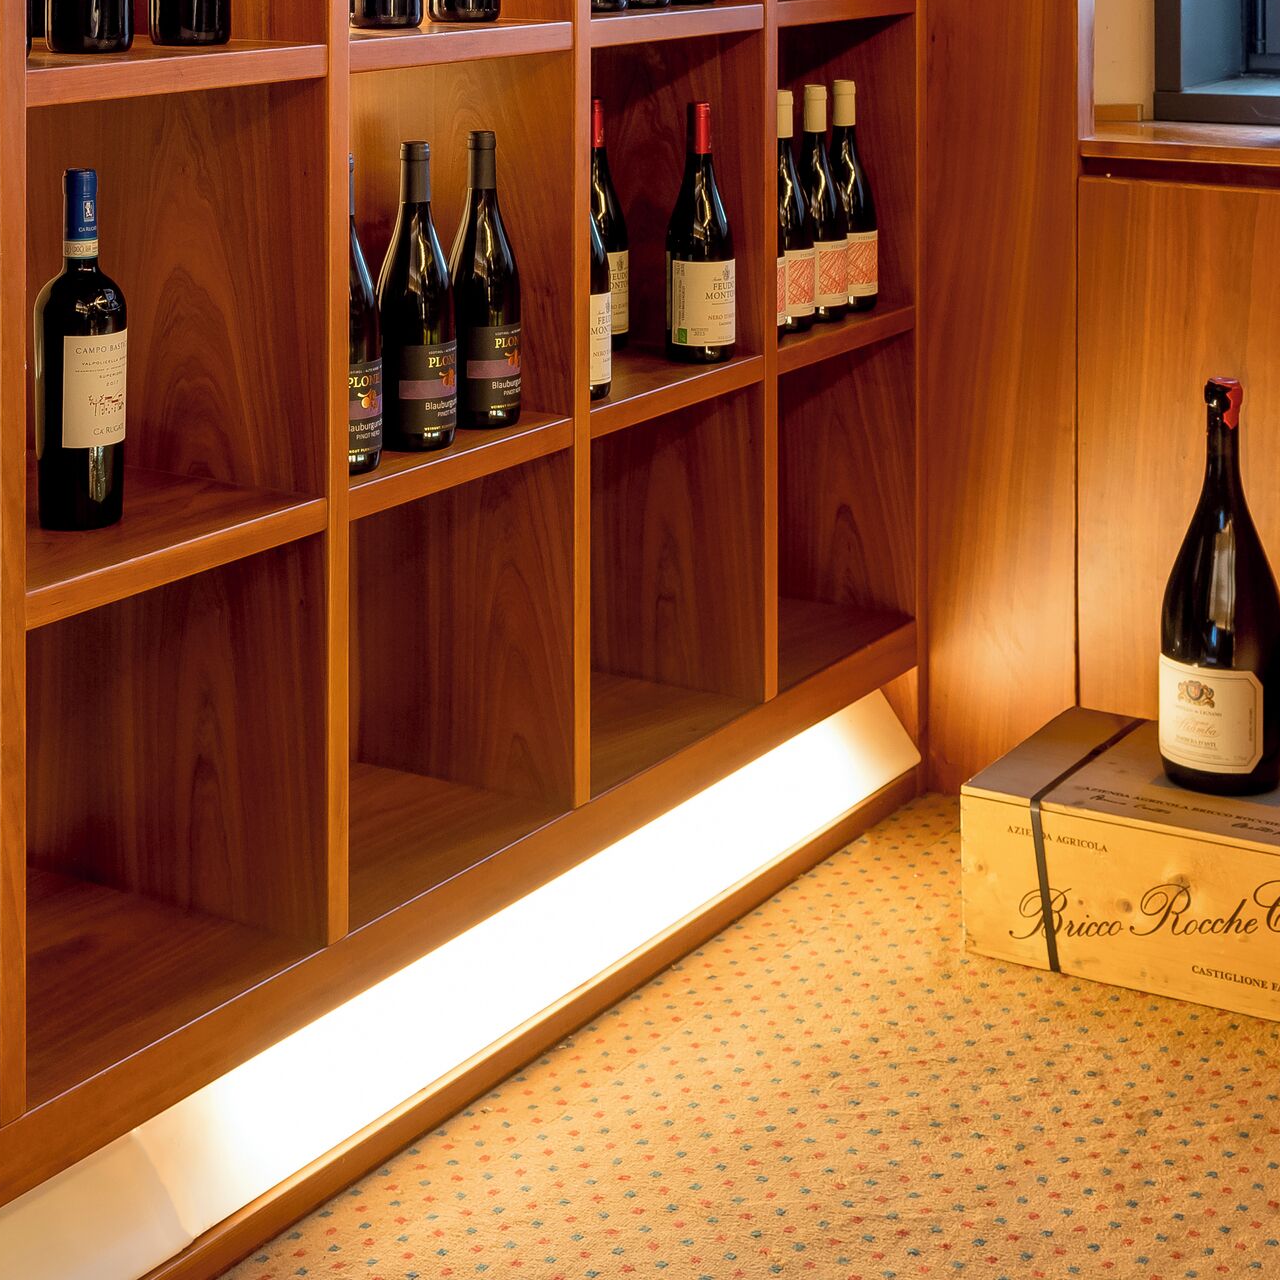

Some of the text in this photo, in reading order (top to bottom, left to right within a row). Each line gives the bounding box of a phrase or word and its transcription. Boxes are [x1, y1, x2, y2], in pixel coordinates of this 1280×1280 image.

[75, 345, 107, 355] CAMPO
[491, 377, 521, 390] Blauburgu
[425, 398, 457, 411] Blauburgu
[356, 432, 369, 440] PINOT
[1081, 785, 1130, 799] AZIENDA
[1131, 795, 1190, 812] AGRICOLA
[1190, 806, 1234, 819] BRICCO
[1007, 825, 1108, 854] AZIEDA AGRICOLA
[1008, 886, 1124, 940] Bricco
[1129, 882, 1259, 939] Rocche
[1191, 964, 1269, 991] CASTIGLIONE
